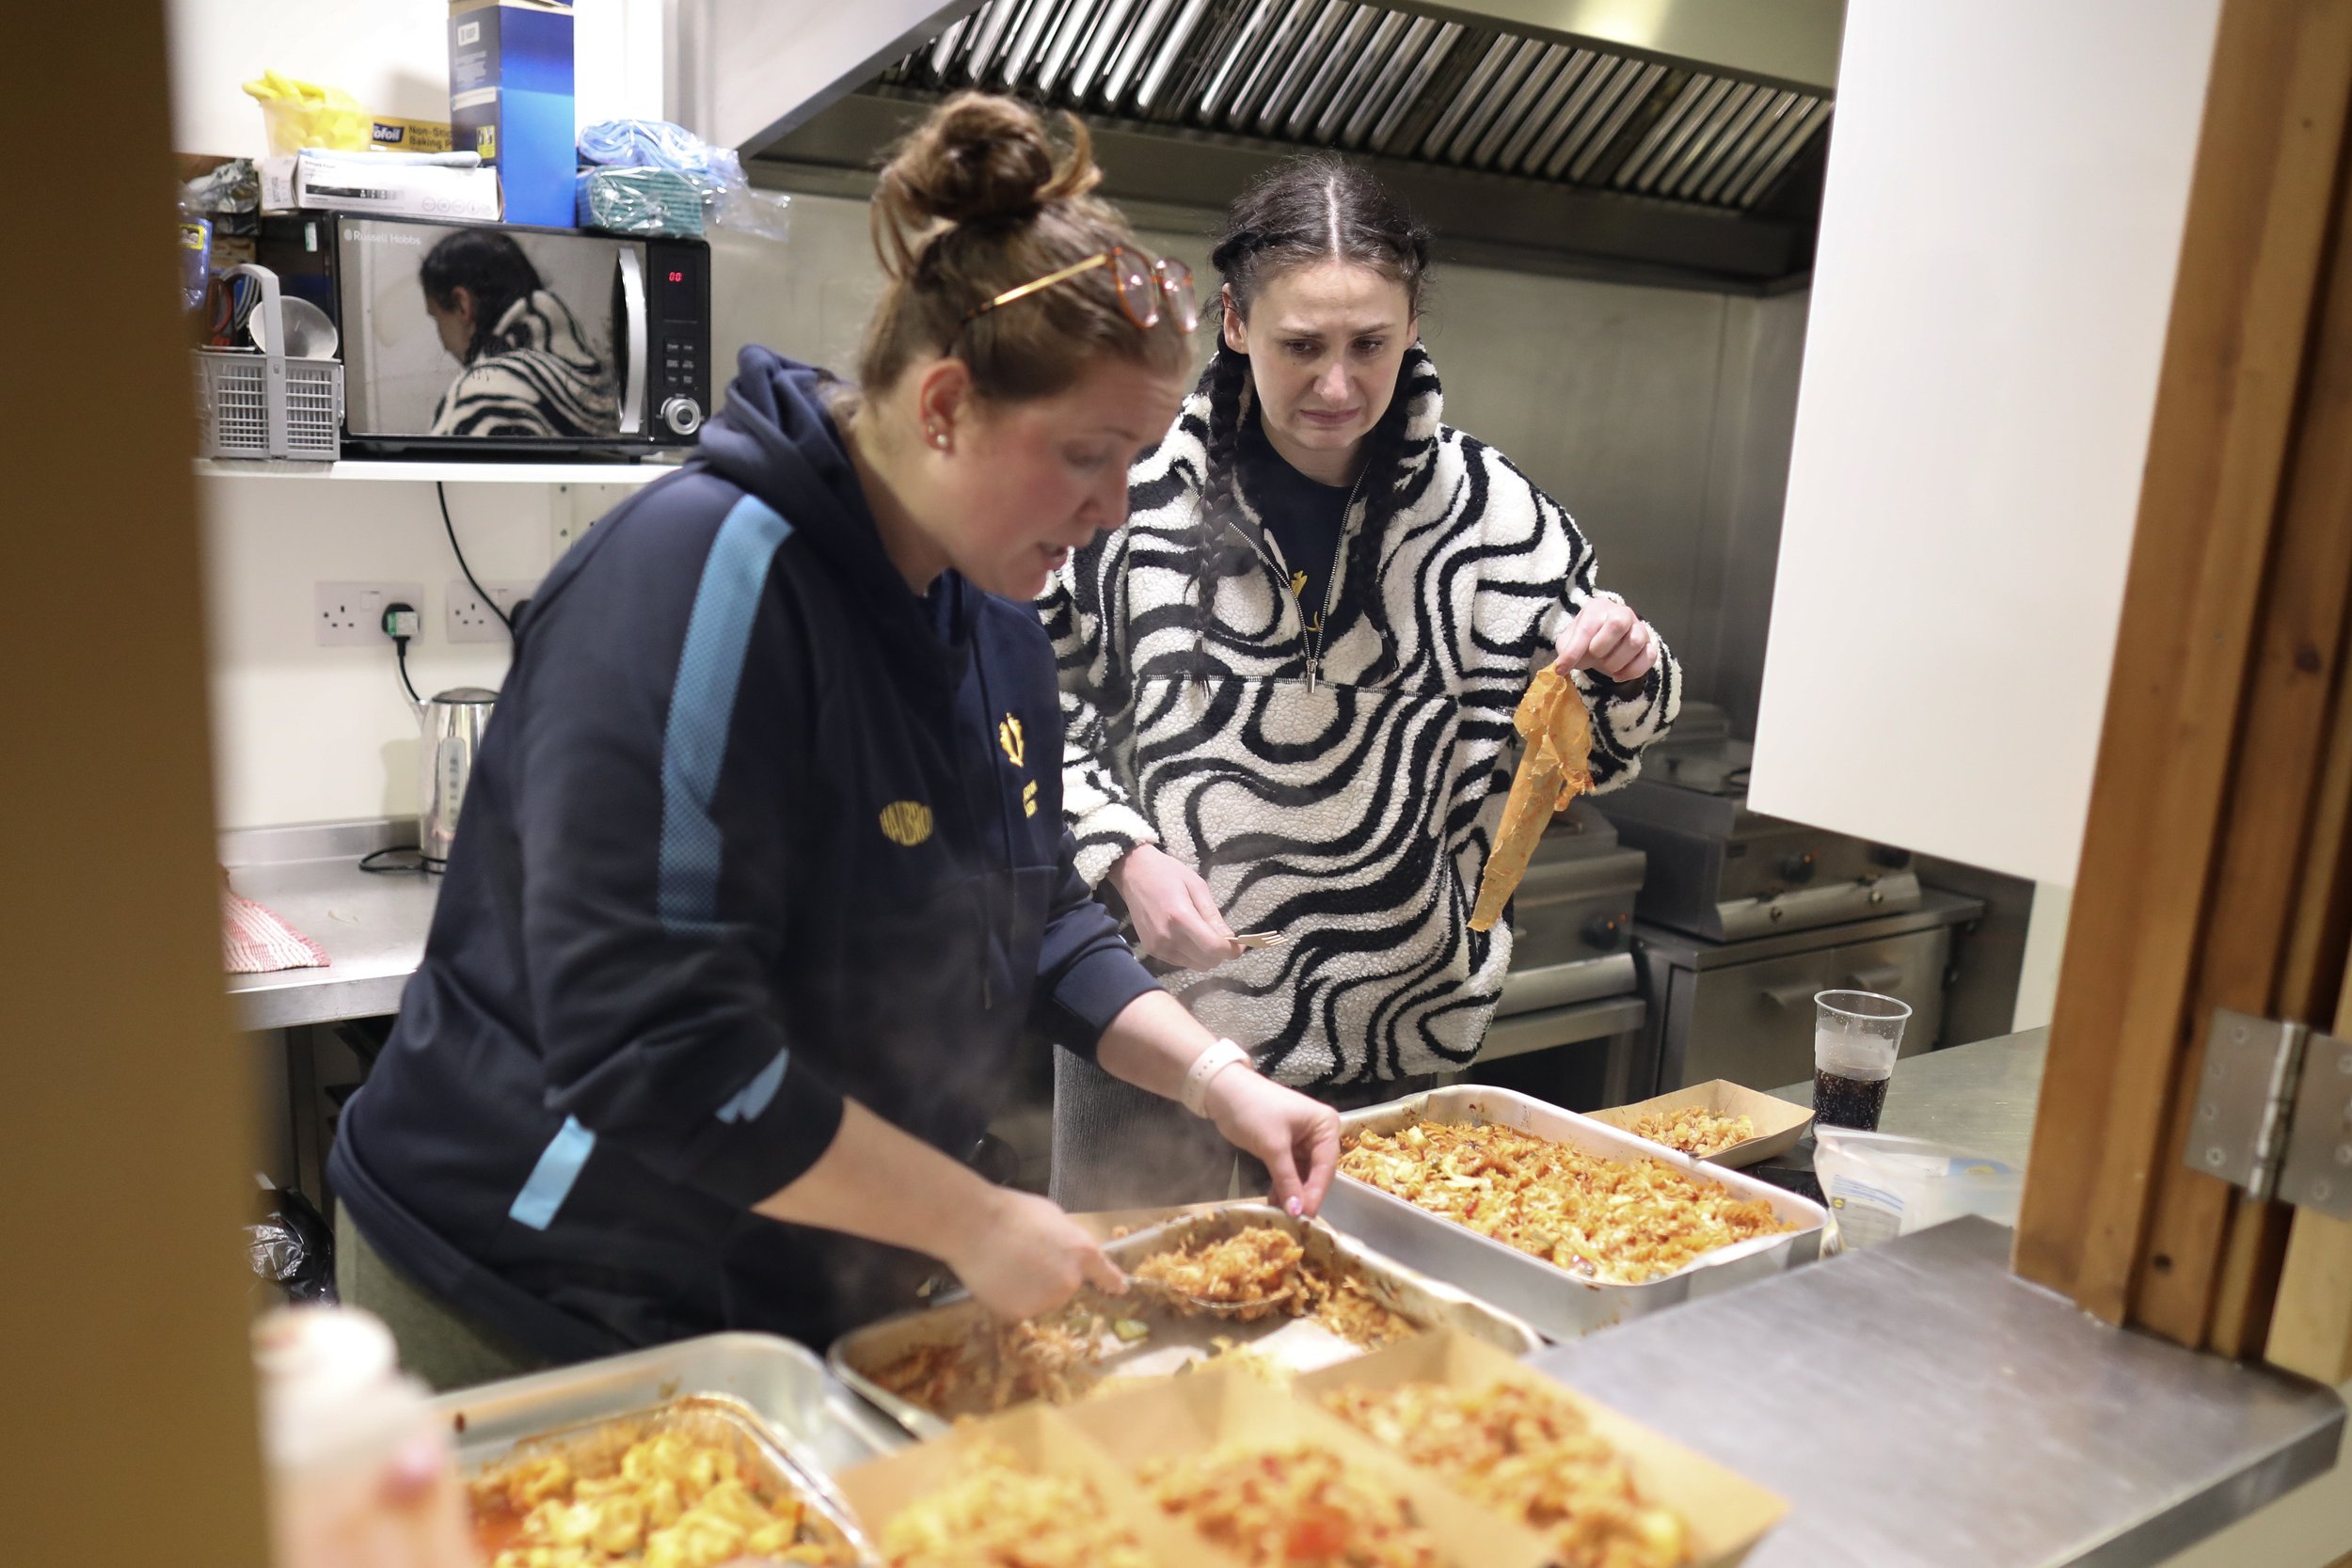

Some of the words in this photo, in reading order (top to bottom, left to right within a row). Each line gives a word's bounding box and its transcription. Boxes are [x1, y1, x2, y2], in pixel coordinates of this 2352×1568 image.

[373, 126, 401, 141] ofoil
[353, 230, 388, 243] Russell
[389, 232, 421, 245] Hobbs
